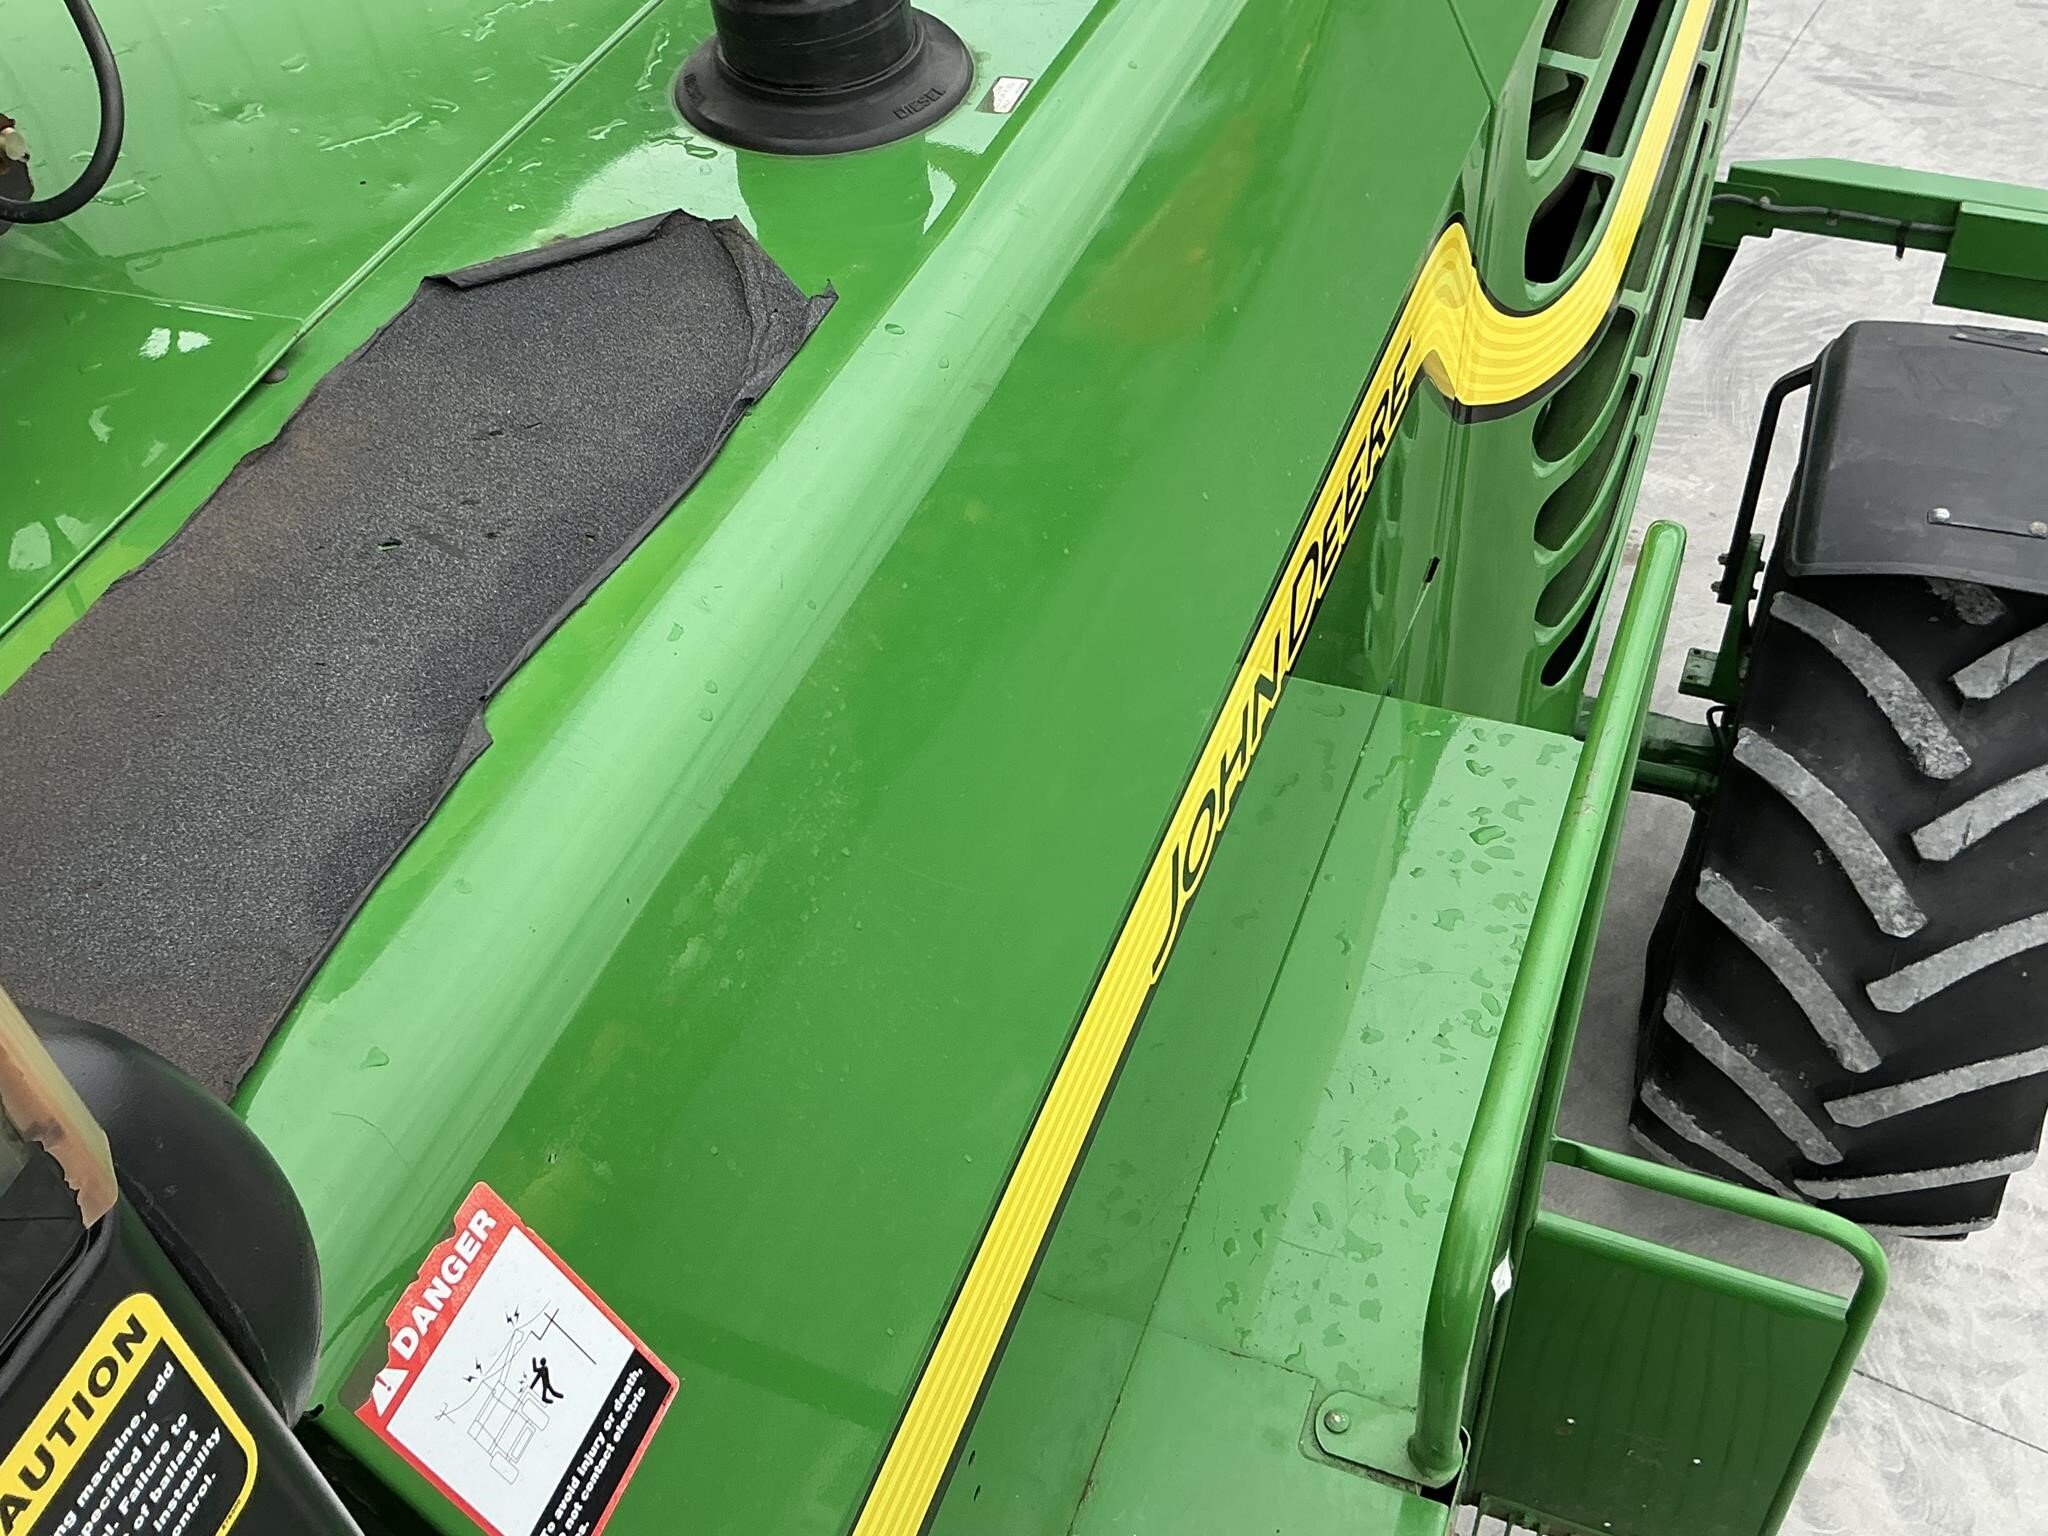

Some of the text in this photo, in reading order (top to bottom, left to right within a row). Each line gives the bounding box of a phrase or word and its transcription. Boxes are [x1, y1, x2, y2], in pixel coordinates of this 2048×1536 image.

[893, 87, 946, 120] DIESEL
[1151, 334, 1413, 980] JOHN DEERE
[391, 1208, 497, 1361] DANGER
[0, 1313, 148, 1536] AUTION
[77, 1410, 147, 1508] machine,
[147, 1361, 174, 1405] add
[77, 1423, 159, 1536] pecified in
[118, 1440, 170, 1515] Failure
[170, 1413, 188, 1436] to
[133, 1430, 199, 1530] of ballast
[152, 1426, 220, 1532] instability
[554, 1475, 580, 1520] avoid
[576, 1431, 605, 1477] injury
[603, 1412, 615, 1431] or
[614, 1368, 643, 1412] death,
[564, 1386, 646, 1530] not contact electric
[172, 1473, 216, 1536] ontrol.
